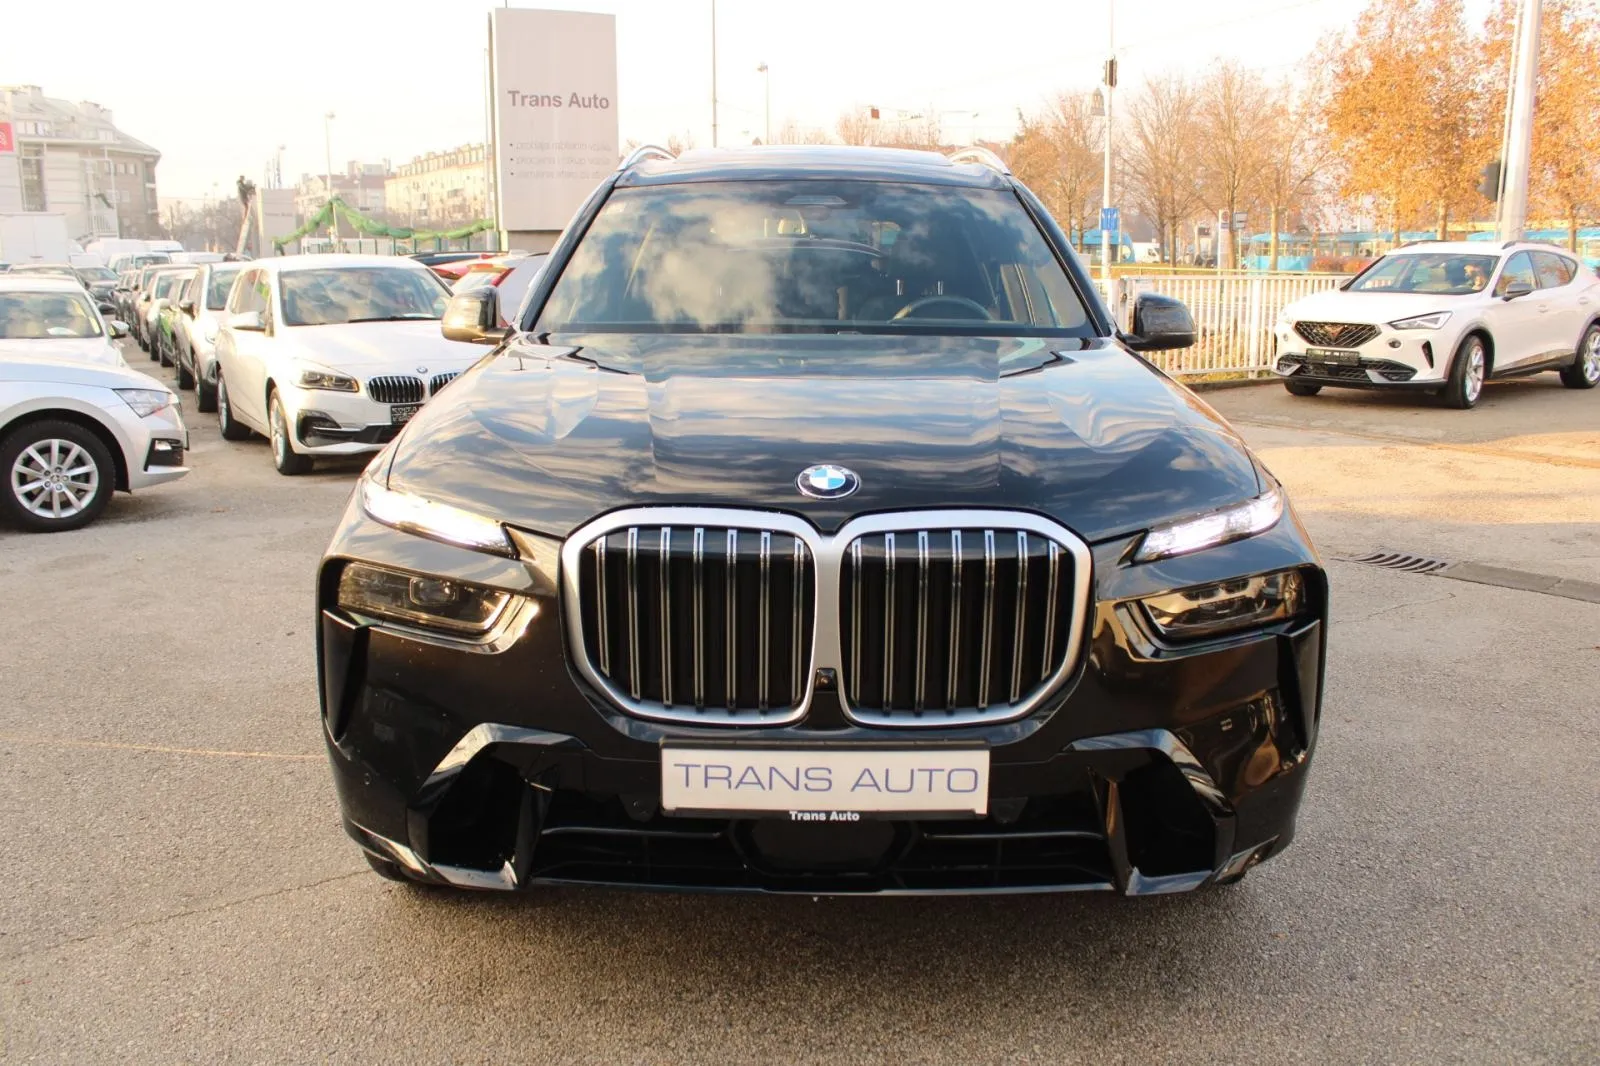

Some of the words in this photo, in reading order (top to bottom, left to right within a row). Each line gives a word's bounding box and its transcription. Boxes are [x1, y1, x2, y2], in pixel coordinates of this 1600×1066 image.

[507, 90, 563, 108] Trans
[568, 92, 610, 109] Auto
[673, 763, 833, 793] TRANS
[850, 767, 979, 794] AUTO
[789, 810, 827, 821] Trans
[829, 810, 860, 821] Auto
